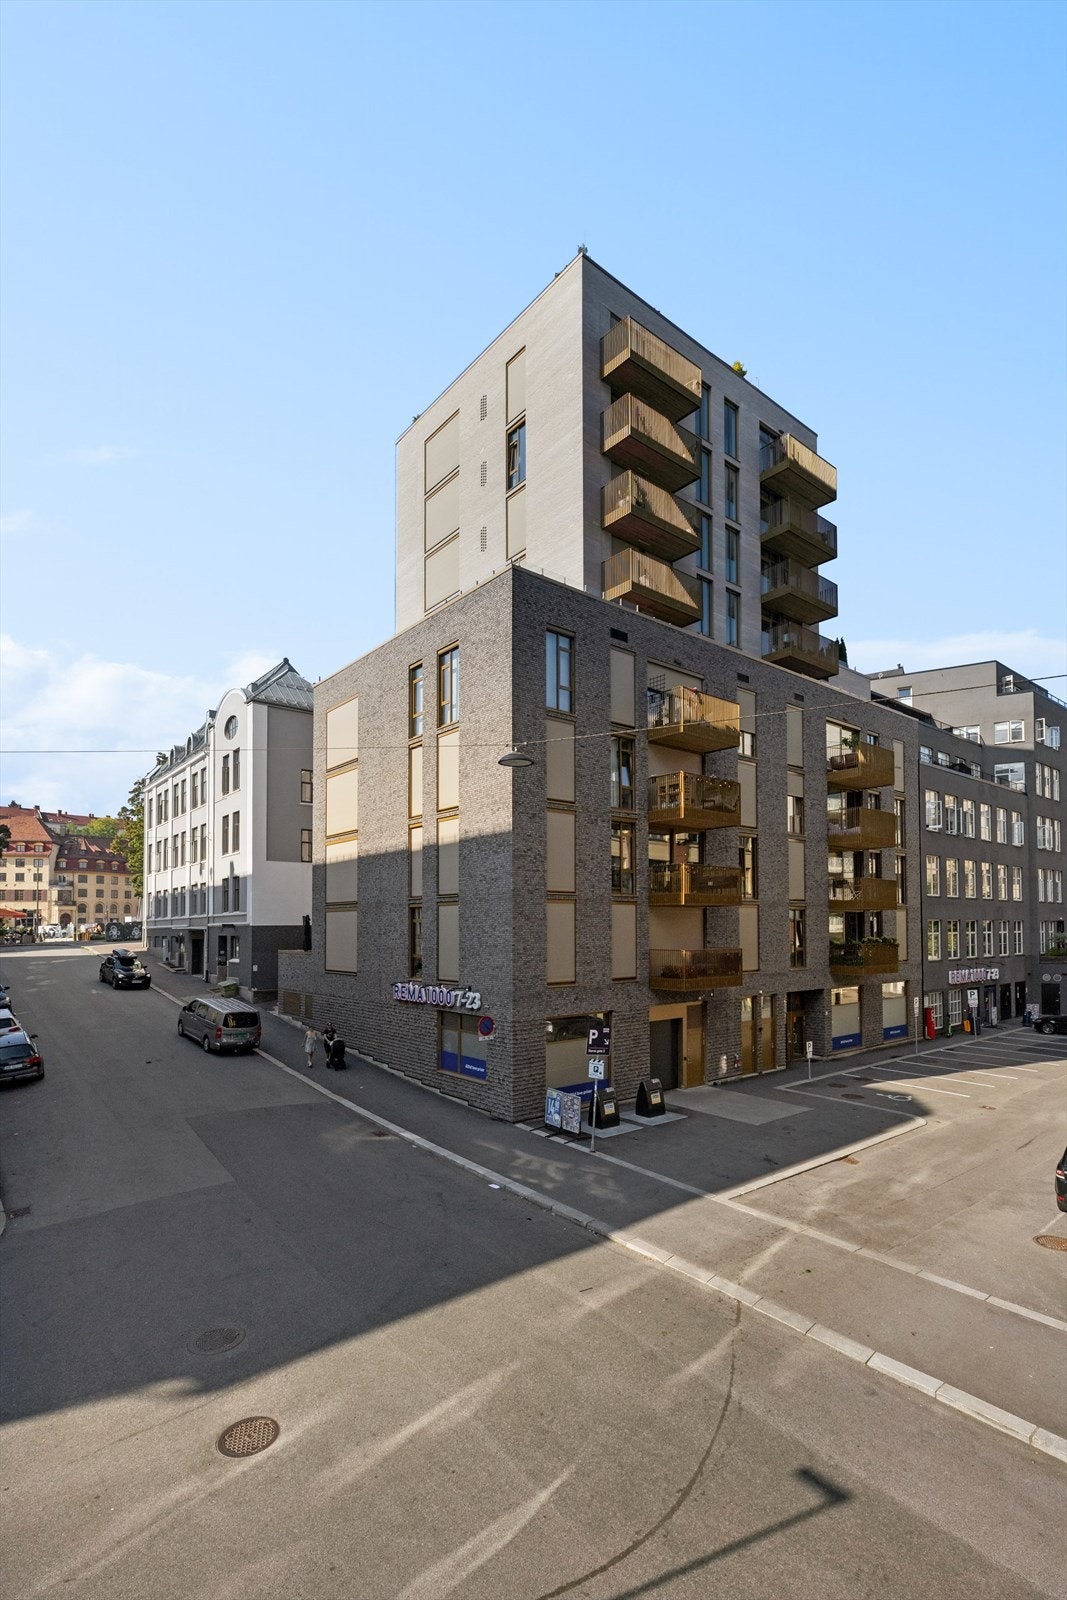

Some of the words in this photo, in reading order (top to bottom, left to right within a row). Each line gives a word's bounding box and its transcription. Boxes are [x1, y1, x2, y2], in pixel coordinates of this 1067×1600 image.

[393, 982, 426, 1002] REMA
[426, 986, 454, 1006] 1000
[454, 989, 481, 1010] 7-23
[589, 1029, 599, 1045] P
